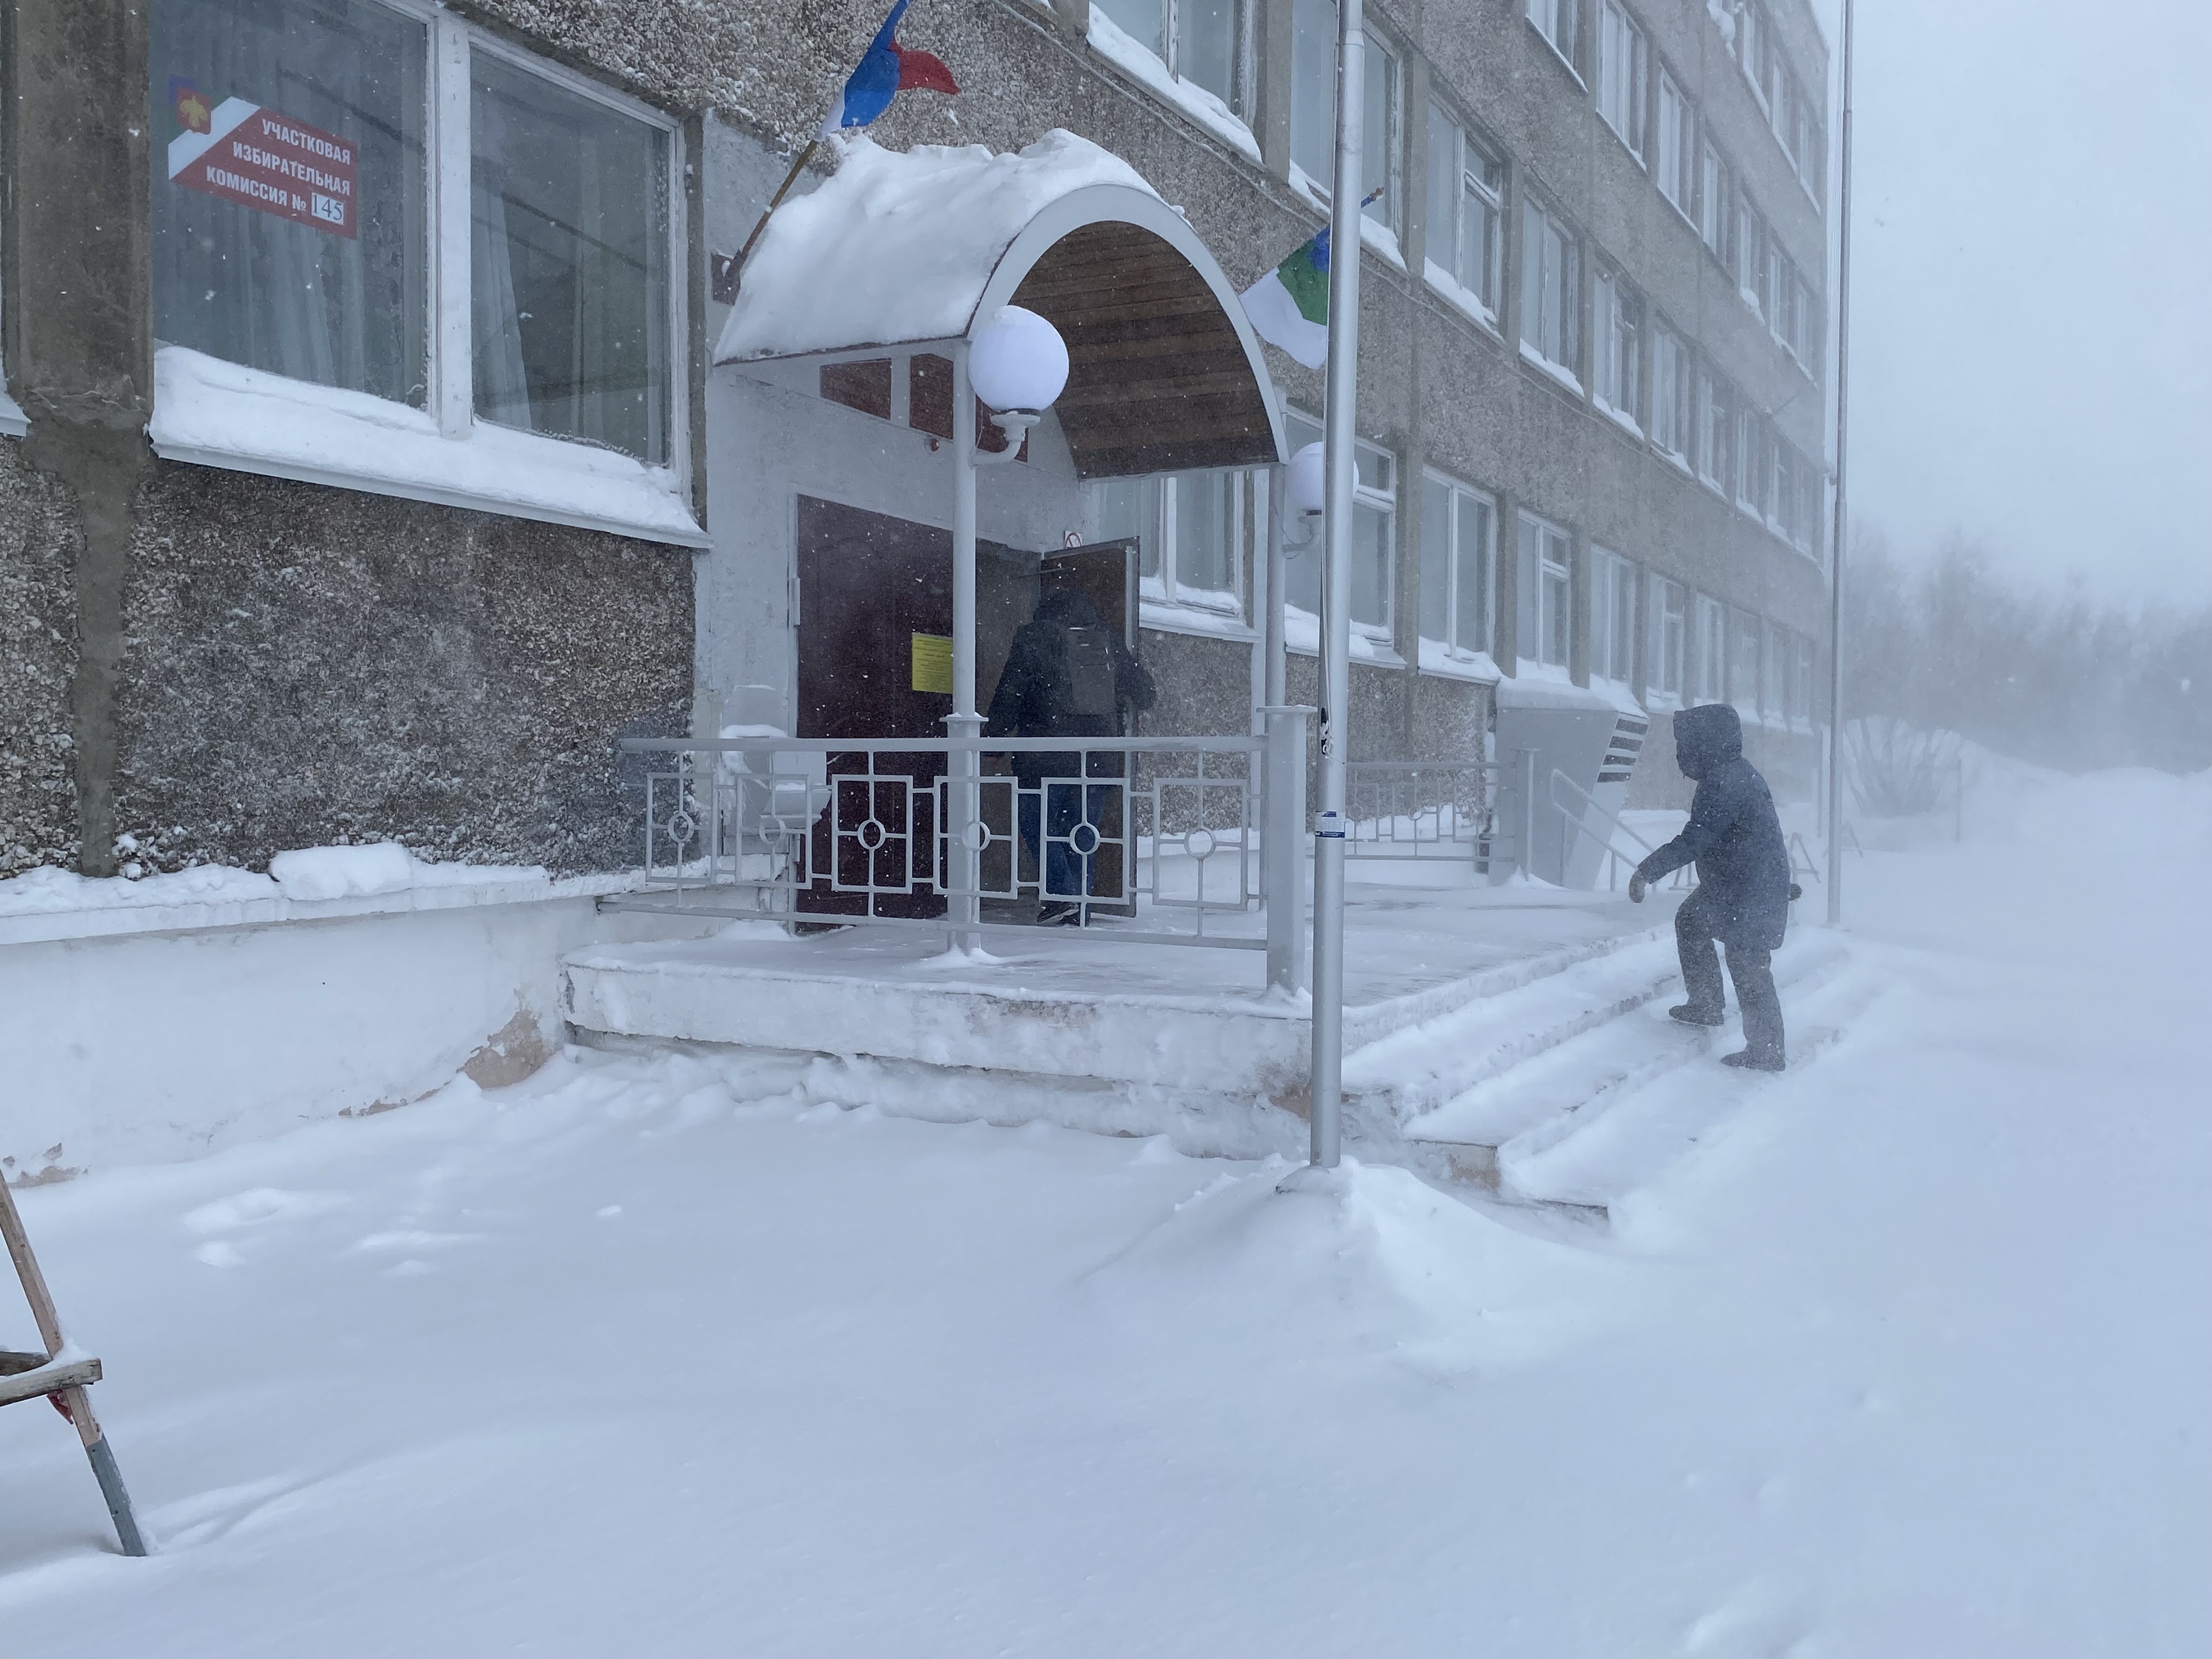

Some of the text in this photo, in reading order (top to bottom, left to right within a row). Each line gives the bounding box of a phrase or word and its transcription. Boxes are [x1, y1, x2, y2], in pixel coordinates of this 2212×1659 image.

[233, 142, 350, 196] ИЗБИРАТЕЛЬНАЯ
[262, 119, 351, 165] УЧАСТКОВАЯ
[206, 166, 343, 221] КОМИССИЯ № 145
